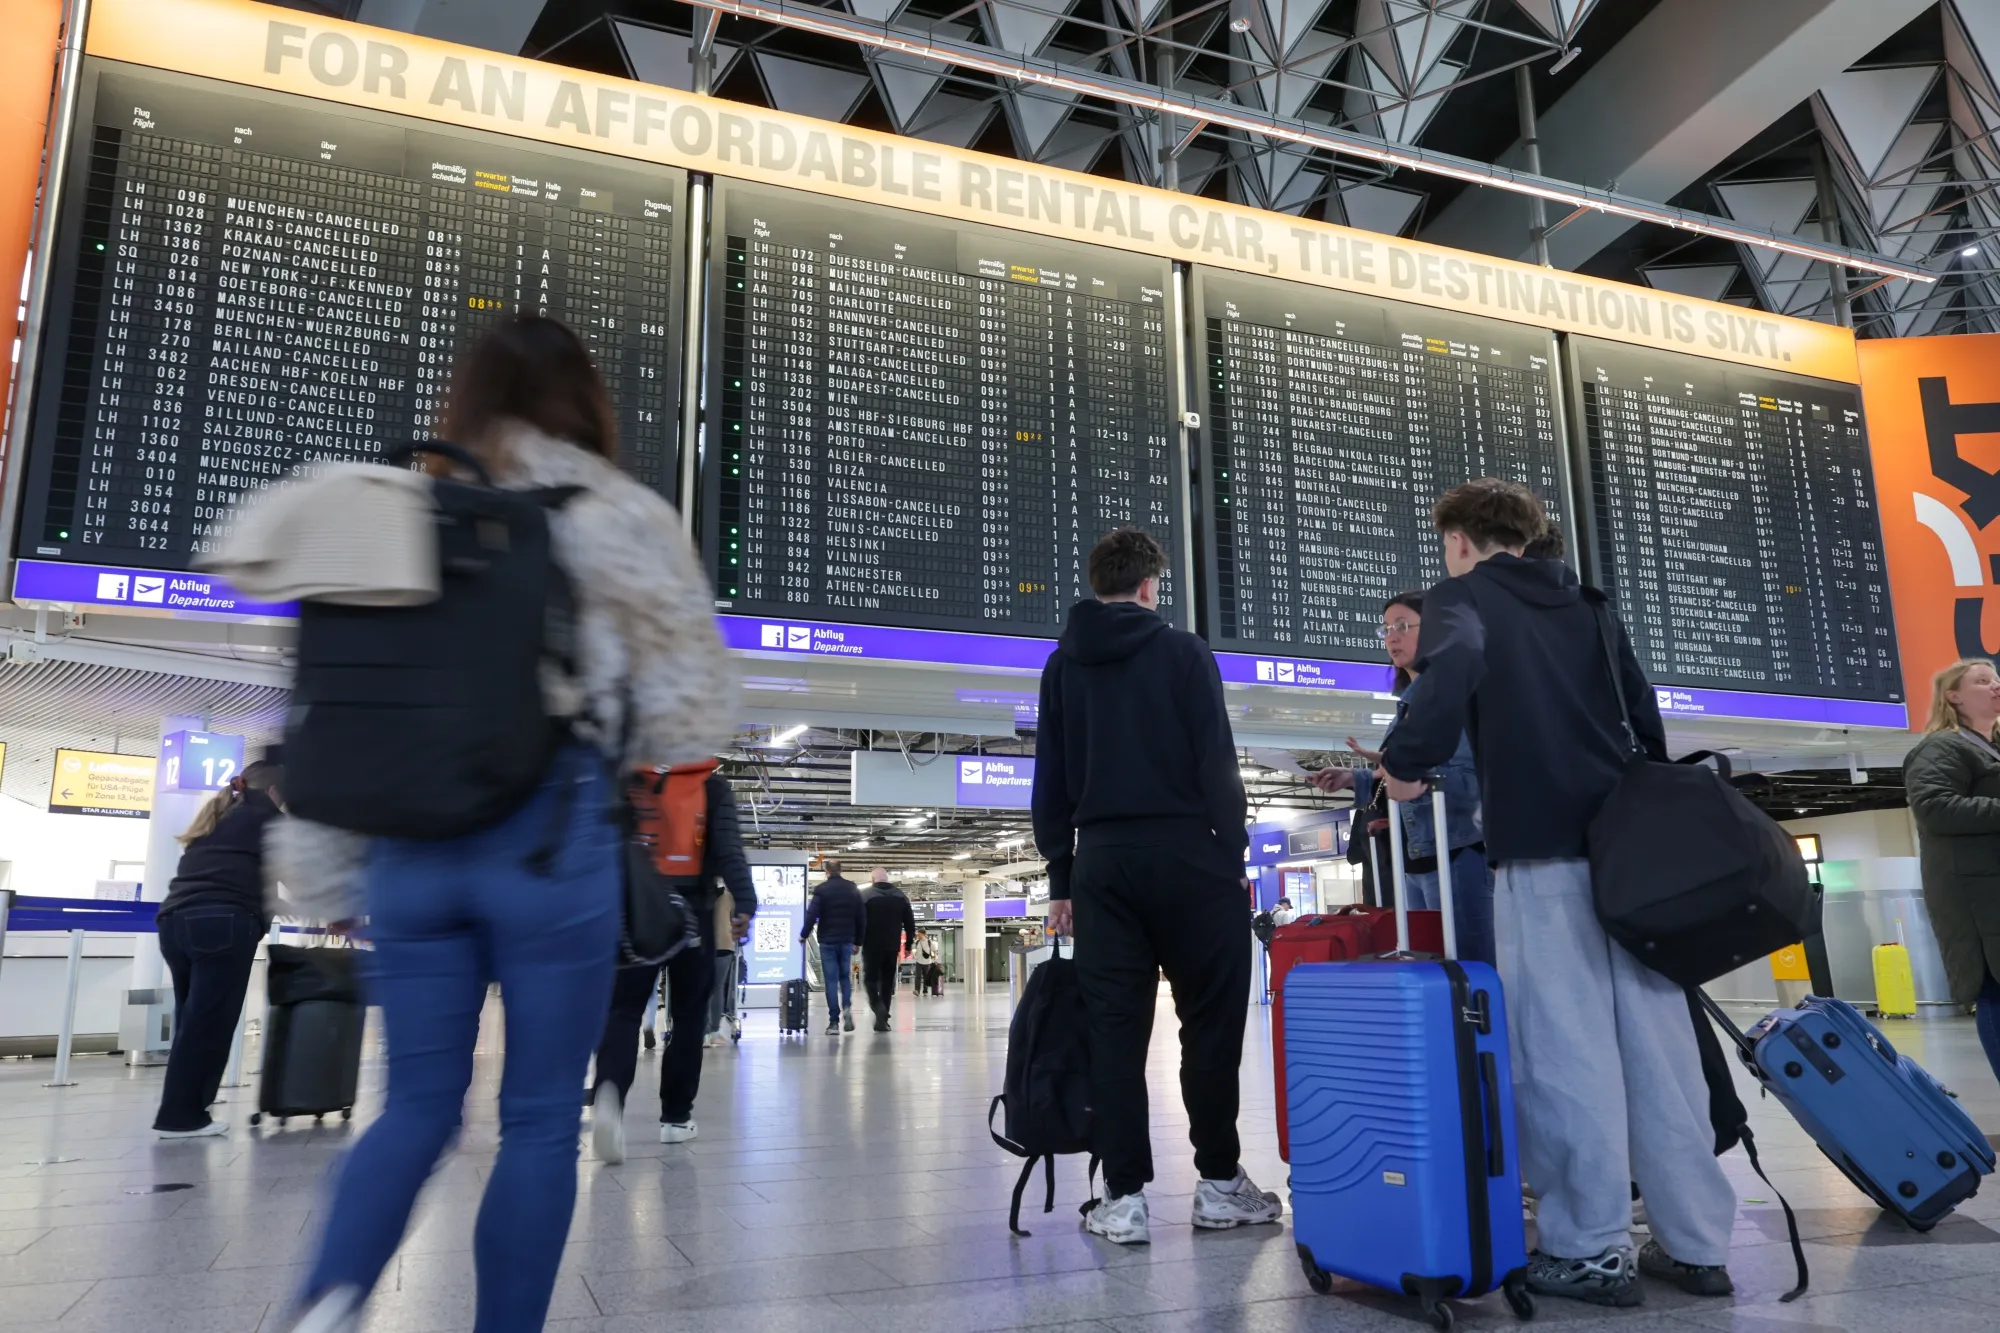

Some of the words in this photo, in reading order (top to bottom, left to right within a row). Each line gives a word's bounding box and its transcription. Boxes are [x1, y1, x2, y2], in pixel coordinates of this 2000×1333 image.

[134, 107, 150, 118] Flug
[132, 118, 155, 129] Flight
[234, 126, 252, 136] nach
[321, 141, 337, 151] über
[320, 152, 332, 160] via
[432, 162, 466, 176] planmäßig
[475, 170, 508, 182] erwartet
[432, 172, 466, 184] scheduled
[474, 180, 510, 192] estimated
[512, 176, 538, 188] Terminal
[264, 20, 409, 98] FOR
[429, 57, 526, 122] AN
[546, 81, 942, 199] AFFORDABLE
[959, 160, 1155, 241] RENTAL
[1169, 204, 1278, 274] CAR,
[1291, 229, 1376, 284] THE
[1389, 251, 1651, 336] DESTINATION
[1660, 302, 1695, 344] IS
[1705, 311, 1791, 361] SIXT.
[512, 185, 538, 197] Terminal
[545, 182, 562, 192] Halle
[580, 188, 596, 198] Zone
[545, 192, 558, 200] Hall
[126, 180, 145, 194] LH
[178, 189, 206, 203] 096
[227, 197, 398, 235] MUENCHEN-CANCELLED
[644, 200, 672, 212] Flugsteig
[644, 208, 658, 218] Gate
[226, 212, 369, 245] PARIS-CANCELLED
[224, 228, 377, 262] KRAKAU-CANCELLED
[222, 244, 376, 277] POZNAN-CANCELLED
[829, 254, 964, 286] DUESSELDR-CANCELLED
[118, 244, 137, 258] SQ
[170, 252, 198, 266] 026
[220, 260, 250, 274] NEW
[262, 266, 412, 298] YORK-J.F.KENNEDY
[641, 323, 663, 336] B46
[219, 275, 401, 312] GOETEBORG-CANCELLED
[752, 283, 767, 294] AA
[792, 289, 812, 301] 705
[829, 295, 893, 314] CHARLOTTE
[754, 255, 768, 266] LH
[792, 262, 813, 274] 098
[829, 268, 887, 286] MUENCHEN
[1143, 320, 1161, 332] A16
[829, 281, 950, 309] MAILAND-CANCELLED
[217, 291, 400, 327] MARSEILLE-CANCELLED
[829, 308, 958, 337] HANNNVER-CANCELLED
[112, 293, 131, 306] LH
[154, 299, 193, 315] 3450
[216, 307, 409, 344] MUENCHEN-WUERZBURG-N
[640, 366, 654, 378] T5
[214, 323, 370, 355] BERLIN-CANCELLED
[828, 322, 944, 348] BREMEN-CANCELLED
[1286, 332, 1370, 354] MALTA-CANCELLED
[212, 339, 378, 371] MAILAND-CANCELLED
[829, 336, 965, 365] STUTTGART-CANCELLED
[828, 349, 937, 374] PARIS-CANCELLED
[210, 356, 270, 374] AACHEN
[281, 365, 368, 386] HBF-KOELN
[378, 378, 404, 391] HBF
[1288, 368, 1345, 385] MARRAKESCH
[1229, 371, 1240, 380] AF
[1254, 375, 1276, 386] 1519
[1288, 380, 1317, 393] PARIS
[1346, 389, 1356, 399] DE
[1362, 392, 1395, 405] GAULLE
[207, 388, 374, 419] VENEDIG-CANCELLED
[1289, 392, 1391, 416] BERLIN-BRANDENBURG
[1646, 393, 1669, 404] KAIRO
[750, 381, 765, 392] OS
[790, 386, 811, 398] 202
[828, 391, 857, 404] WIEN
[1148, 435, 1166, 446] A18
[828, 405, 849, 418] DUS
[858, 409, 945, 430] HBF-SIEGBURG
[953, 422, 972, 434] HBF
[1647, 404, 1733, 425] KOPENHAGE-CANCELLED
[98, 410, 117, 423] LH
[143, 415, 180, 430] 1102
[203, 421, 381, 452] SALZBURG-CANCELLED
[827, 420, 966, 447] AMSTERDAM-CANCELLED
[1291, 417, 1392, 440] BUKAREST-CANCELLED
[1292, 429, 1315, 441] RIGA
[1650, 426, 1732, 446] SARAJEVO-CANCELLED
[827, 434, 864, 448] PORTO
[827, 448, 945, 472] ALGIER-CANCELLED
[1292, 442, 1332, 456] BELGRAD
[1338, 448, 1372, 461] NIKOLA
[1378, 454, 1405, 465] TESLA
[1293, 454, 1401, 477] BARCELONA-CANCELLED
[749, 453, 764, 464] 4Y
[789, 458, 810, 470] 530
[829, 463, 864, 476] IBIZA
[1150, 501, 1162, 511] A2
[827, 477, 887, 493] VALENCIA
[1655, 470, 1697, 483] AMSTERDAM
[1294, 479, 1340, 494] MONTREAL
[87, 496, 107, 509] LH
[130, 500, 170, 515] 3604
[827, 491, 960, 515] LISSABON-CANCELLED
[1658, 503, 1723, 520] OSLO-CANCELLED
[827, 506, 952, 529] ZUERICH-CANCELLED
[1296, 504, 1382, 523] TORONTO-PEARSON
[1660, 515, 1697, 527] CHISINAU
[1297, 517, 1326, 529] PALMA
[1332, 521, 1343, 531] DE
[1349, 524, 1394, 537] MALLORCA
[1660, 526, 1689, 537] NEAPEL
[83, 530, 103, 544] EY
[140, 536, 167, 549] 122
[826, 535, 884, 550] HELSINKI
[1662, 537, 1727, 553] RALEIGH/DURHAM
[826, 550, 879, 564] VILNIUS
[826, 564, 901, 581] MANCHESTER
[1300, 568, 1386, 586] LONDON-HEATHROW
[1666, 571, 1708, 584] STUTTGART
[1712, 577, 1726, 586] HBF
[170, 578, 210, 595] Abflug
[1667, 583, 1718, 596] DUESSELDORF
[1723, 589, 1736, 598] HBF
[168, 593, 236, 609] Departures
[746, 587, 761, 598] LH
[787, 590, 809, 602] 880
[826, 594, 879, 608] TALLINN
[1302, 594, 1337, 606] ZAGREB
[1303, 620, 1344, 632] ATLANTA
[813, 628, 845, 643] Abflug
[1672, 629, 1686, 639] TEL
[1692, 631, 1729, 642] AVIV-BEN
[1733, 635, 1761, 645] GURION
[813, 640, 864, 656] Departures
[1674, 641, 1712, 652] HURGHADA
[1296, 664, 1320, 676] Abflug
[1297, 674, 1336, 686] Departures
[1672, 692, 1692, 703] Abflug
[1673, 702, 1705, 712] Departures
[166, 756, 180, 786] 12
[202, 758, 236, 786] 12
[986, 762, 1014, 774] Abflug
[986, 774, 1032, 786] Departures
[100, 808, 134, 816] ALLIANCE
